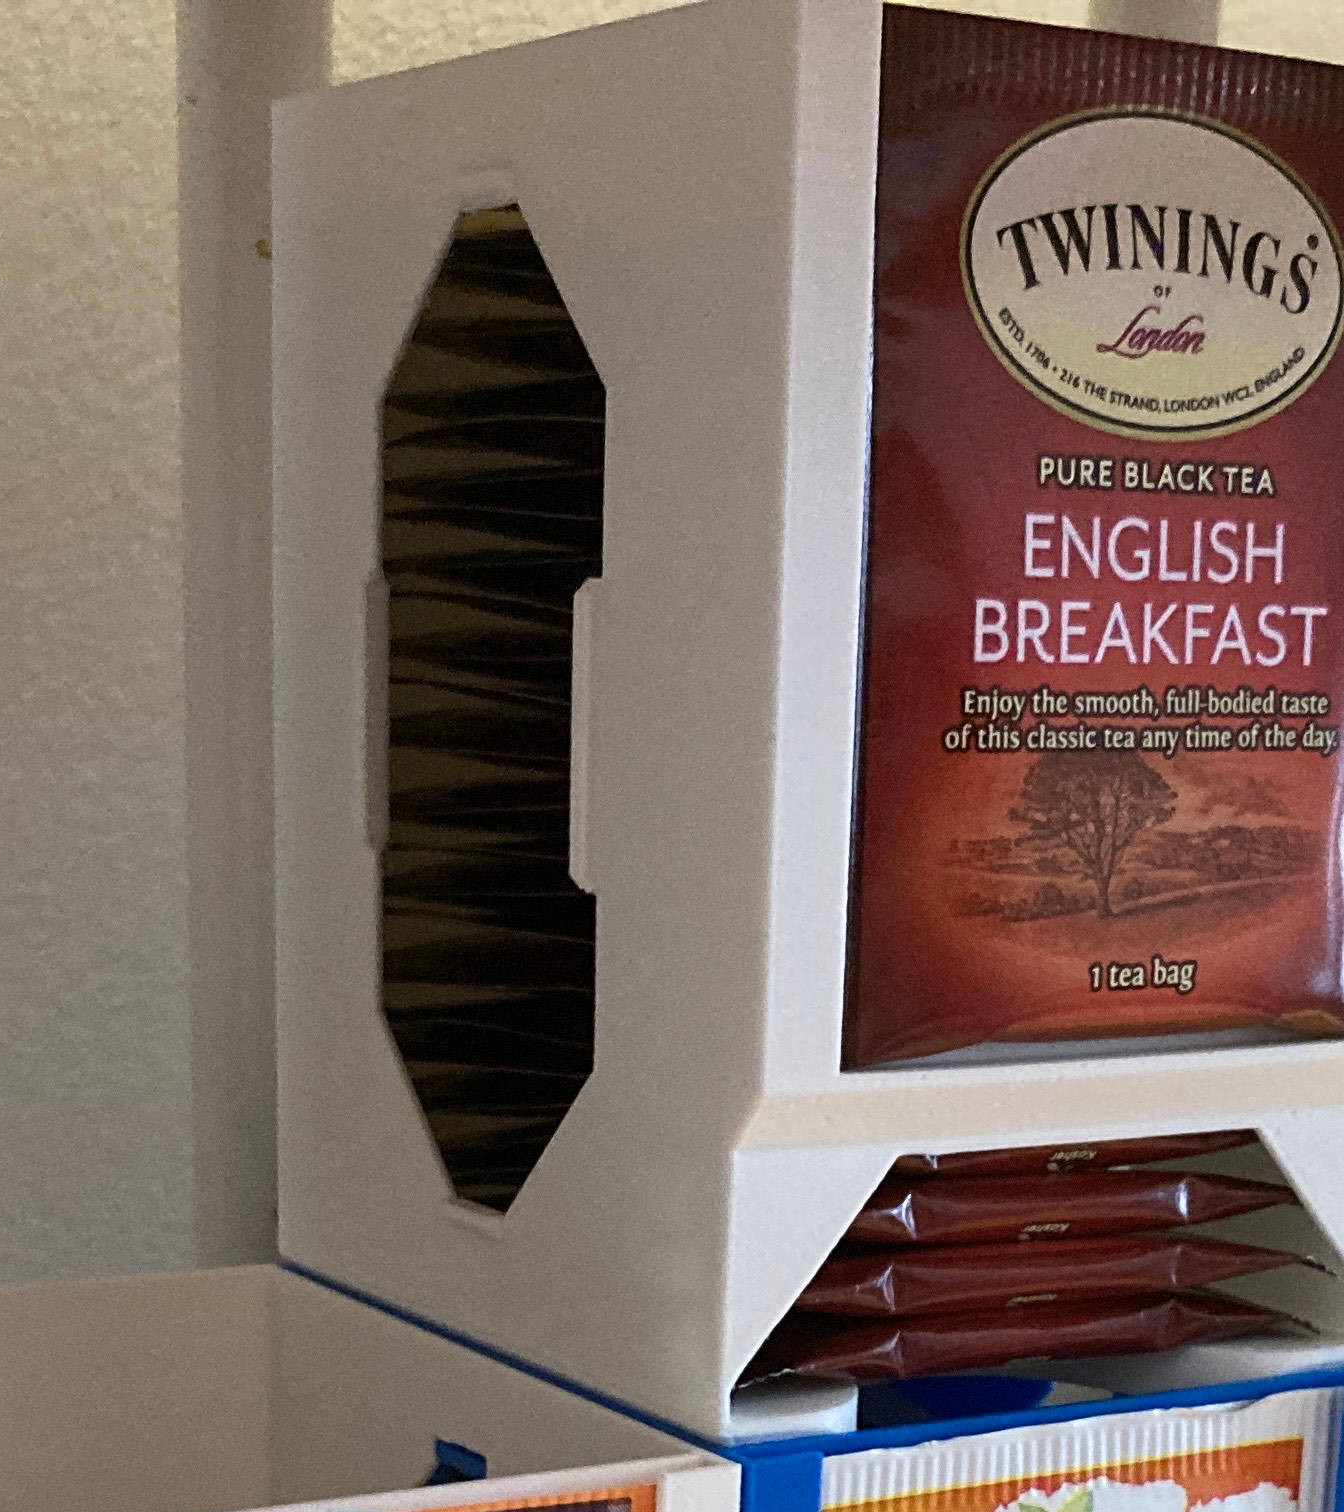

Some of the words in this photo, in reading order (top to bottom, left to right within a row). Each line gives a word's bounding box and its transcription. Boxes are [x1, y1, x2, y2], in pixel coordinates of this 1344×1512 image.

[997, 203, 1320, 314] TWININGS
[1096, 306, 1206, 359] London
[1025, 341, 1050, 369] 1706
[1059, 367, 1081, 389] 216
[1084, 379, 1108, 401] THE
[1164, 392, 1220, 412] LONDON
[1254, 346, 1305, 394] ENGLAND
[1039, 456, 1113, 488] PURE
[1125, 460, 1214, 493] BLACK
[1223, 466, 1274, 495] TEA
[1023, 513, 1286, 584] ENGLISH
[973, 599, 1328, 667] BREAKFAST
[964, 690, 1025, 720] Enjoy
[1033, 689, 1067, 714] the
[1075, 689, 1159, 719] smooth,
[1166, 688, 1274, 714] full-bodied
[1282, 693, 1328, 714] taste
[944, 724, 971, 750] of
[978, 724, 1020, 749] this
[1027, 724, 1096, 749] classic
[1105, 729, 1135, 749] tea
[1143, 730, 1179, 755] any
[1186, 724, 1231, 749] time
[1238, 724, 1262, 749] of
[1264, 724, 1296, 749] the
[1302, 724, 1338, 754] day.
[1091, 965, 1102, 989] 1
[1110, 964, 1145, 988] tea
[1154, 959, 1196, 991] bag
